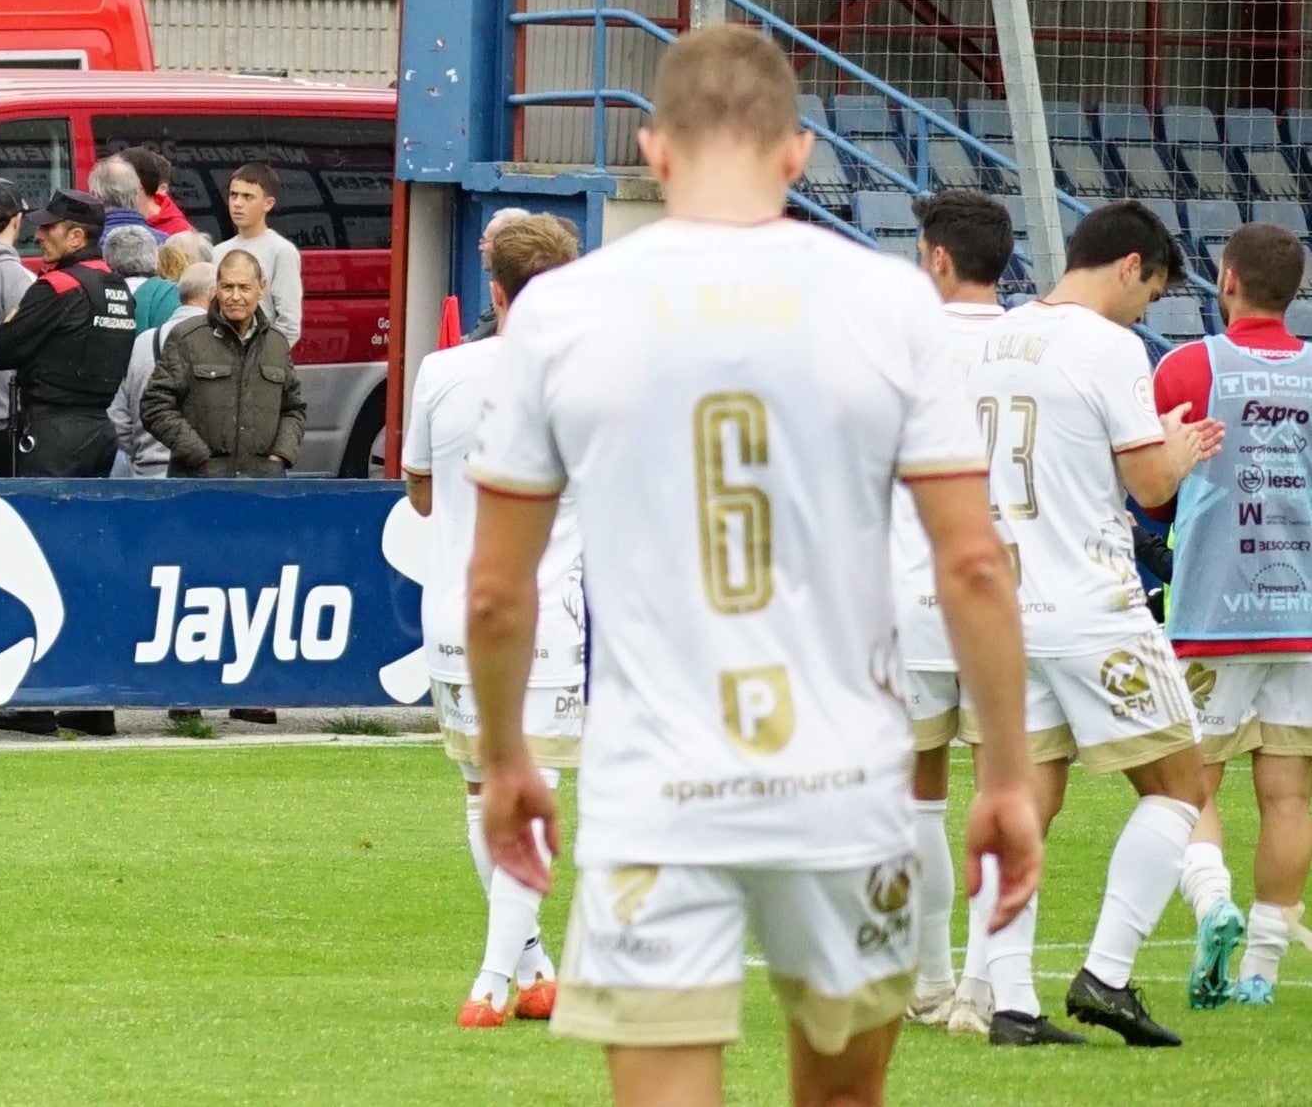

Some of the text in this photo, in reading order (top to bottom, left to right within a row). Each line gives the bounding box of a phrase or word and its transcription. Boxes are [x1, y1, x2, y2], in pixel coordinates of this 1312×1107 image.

[692, 391, 775, 615] 6
[135, 564, 353, 685] Jaylo
[736, 678, 776, 741] P
[661, 767, 867, 803] aparcamurcia
